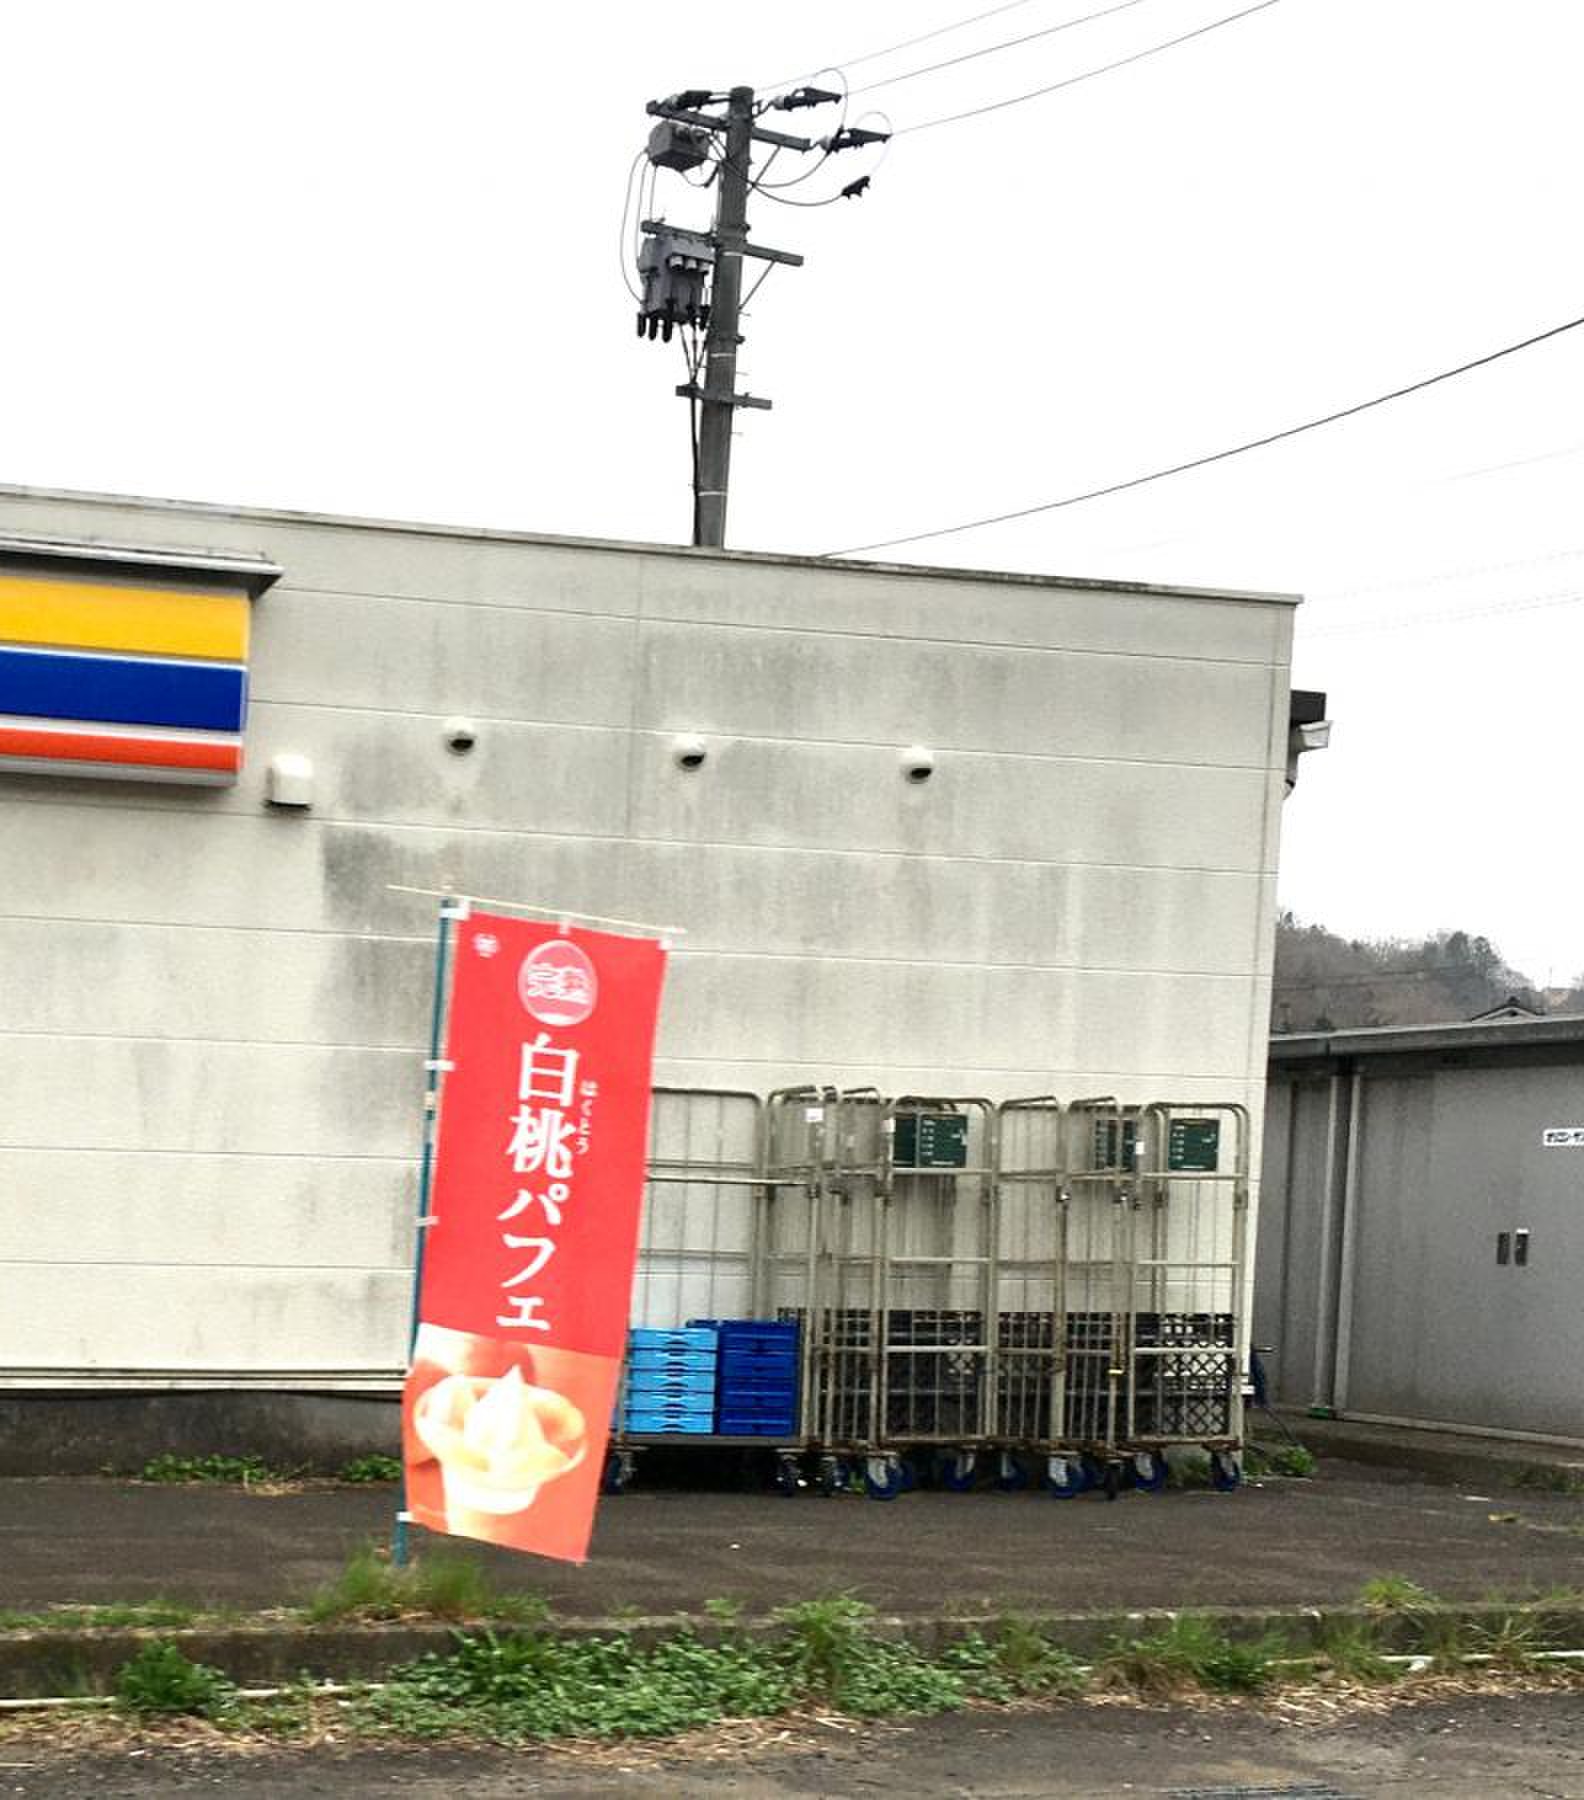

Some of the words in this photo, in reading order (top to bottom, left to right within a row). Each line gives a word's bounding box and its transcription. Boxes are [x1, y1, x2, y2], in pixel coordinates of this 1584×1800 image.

[496, 1032, 580, 1331] 白桃パフェ
[575, 1079, 599, 1156] はくとう
